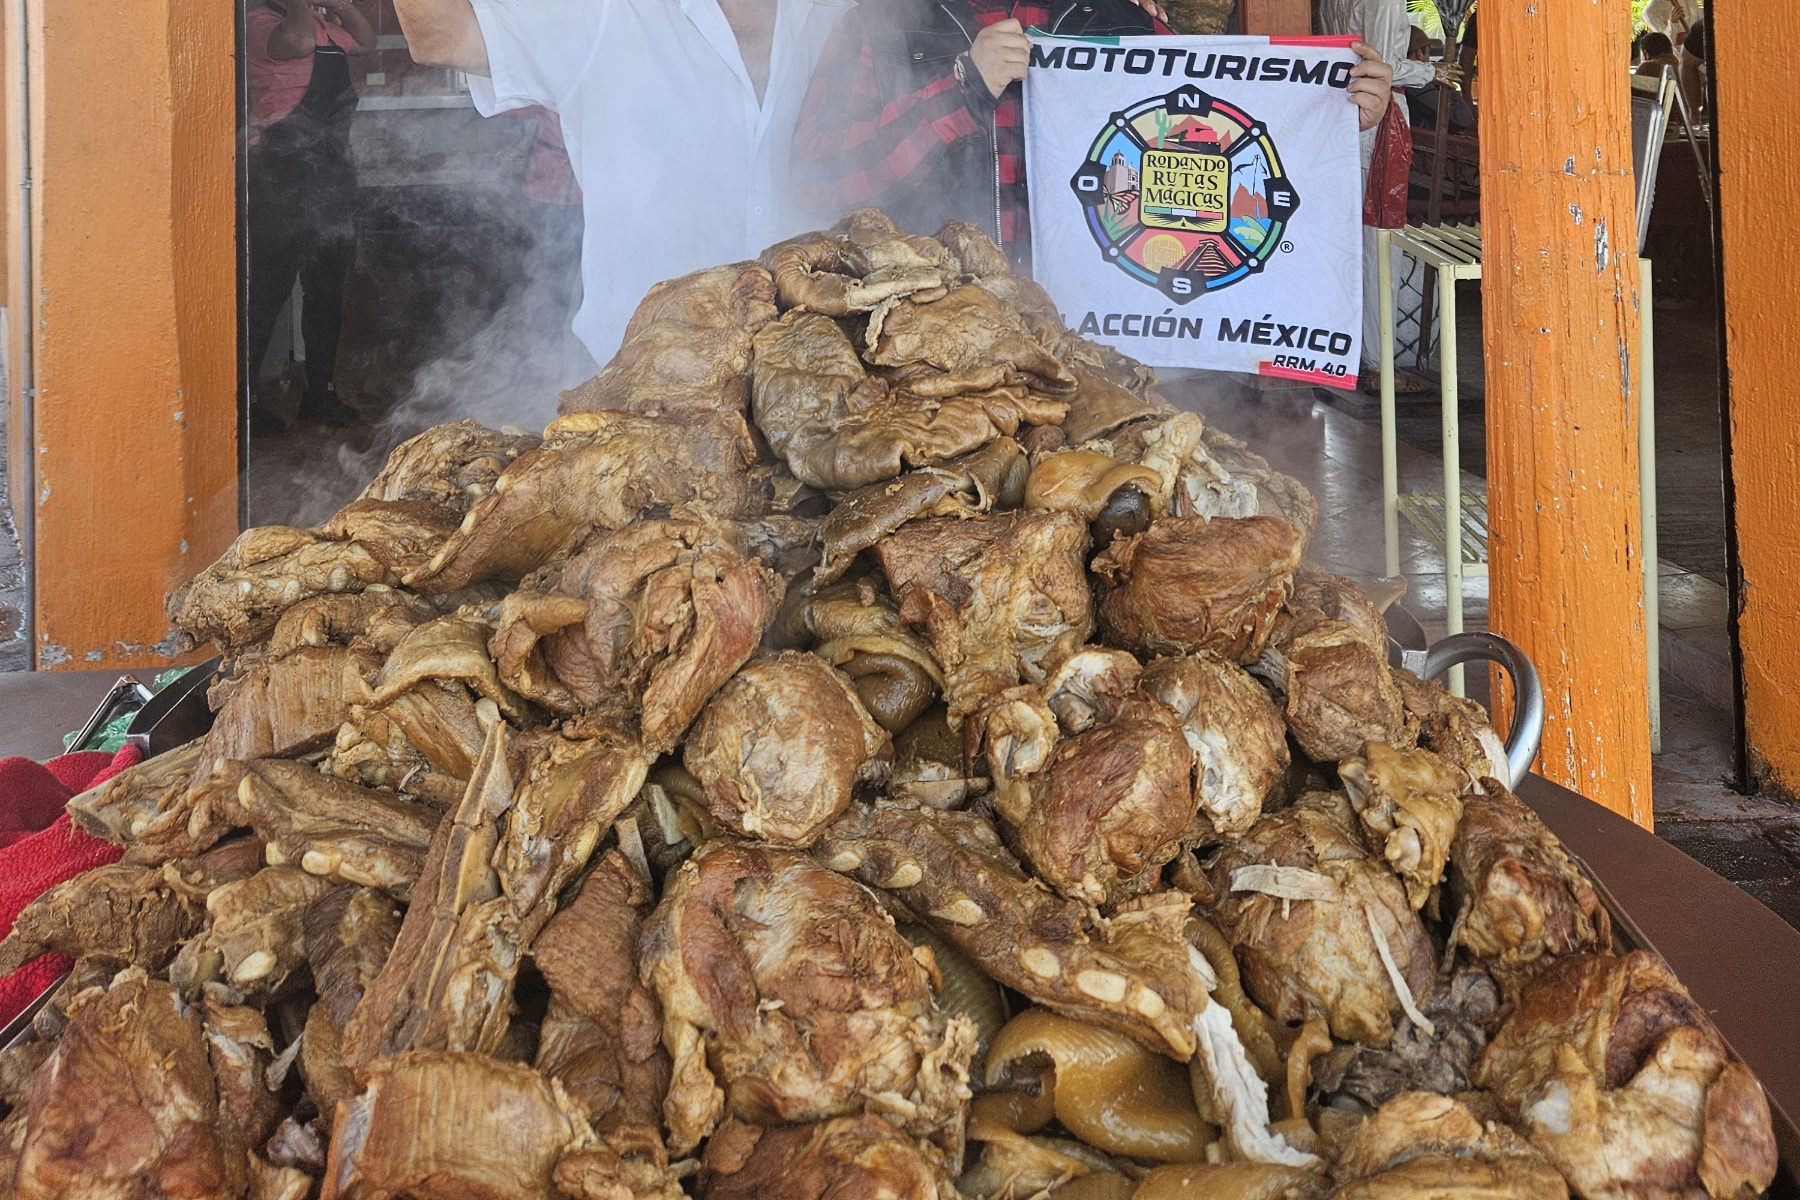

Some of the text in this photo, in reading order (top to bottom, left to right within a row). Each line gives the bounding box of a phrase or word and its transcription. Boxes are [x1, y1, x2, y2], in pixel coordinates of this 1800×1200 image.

[1029, 46, 1354, 89] MOTOTURISMO
[1177, 93, 1200, 108] N
[1077, 176, 1098, 191] O
[1273, 191, 1291, 207] E
[1173, 279, 1192, 294] S
[1078, 308, 1203, 339] ACCIÓN
[1217, 314, 1352, 356] MÉXICO
[1273, 355, 1347, 376] RRM 4.0
